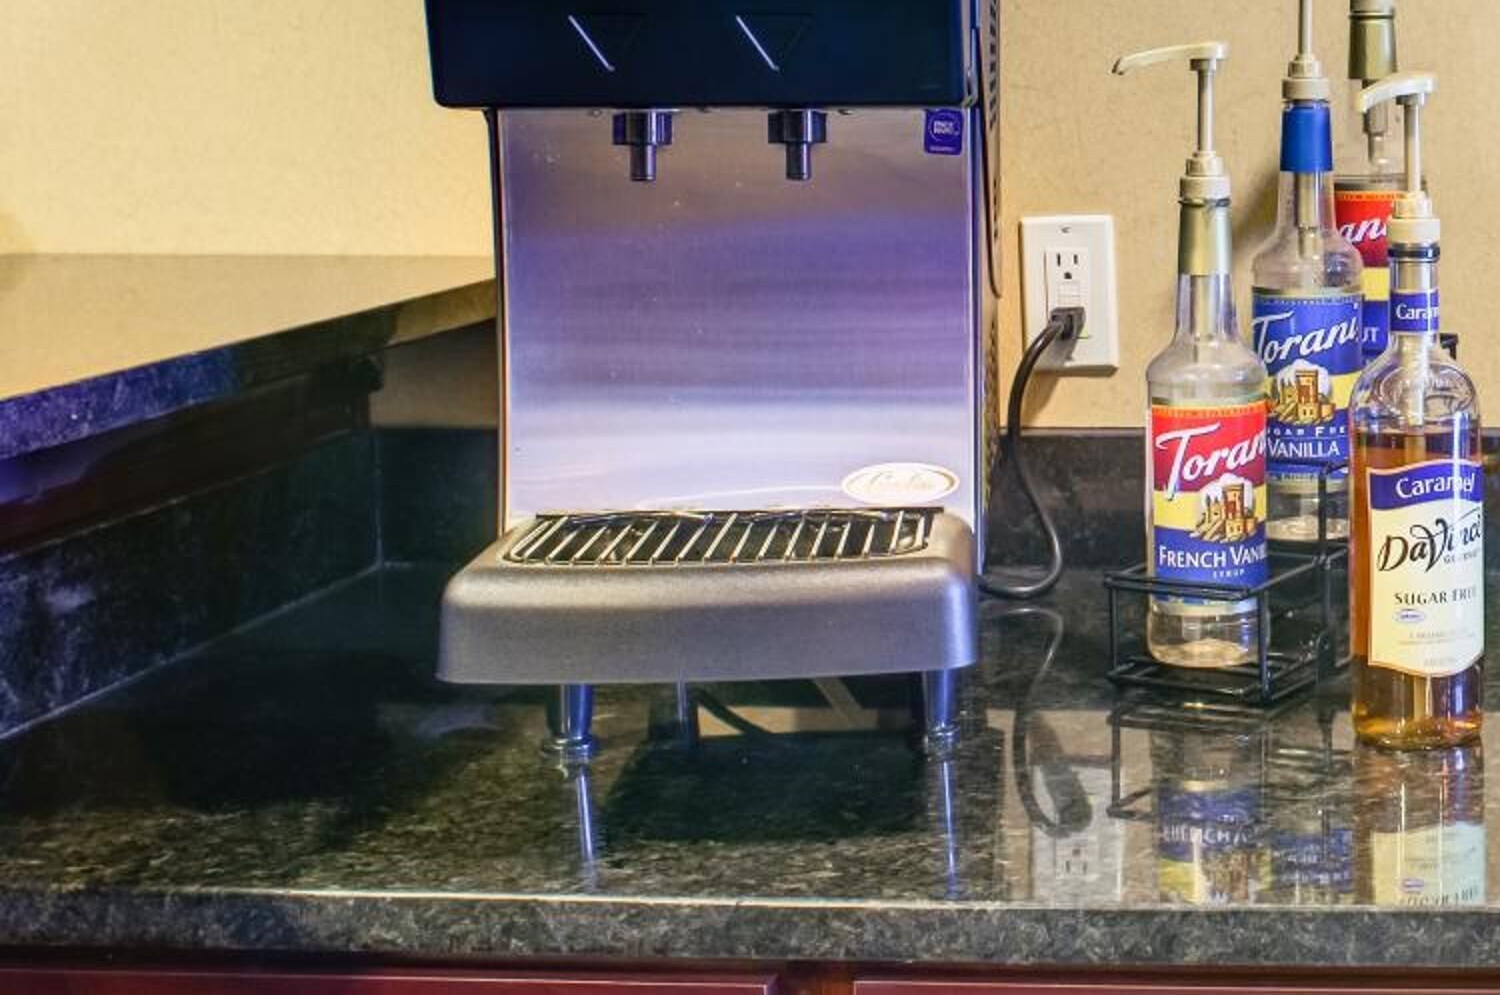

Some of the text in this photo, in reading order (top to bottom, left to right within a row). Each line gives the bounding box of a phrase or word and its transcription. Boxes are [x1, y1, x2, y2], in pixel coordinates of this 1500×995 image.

[1267, 437, 1341, 457] VANILLA
[1396, 474, 1475, 499] Caramel
[1159, 545, 1227, 568] FRENCH
[1394, 591, 1448, 605] SUGAR
